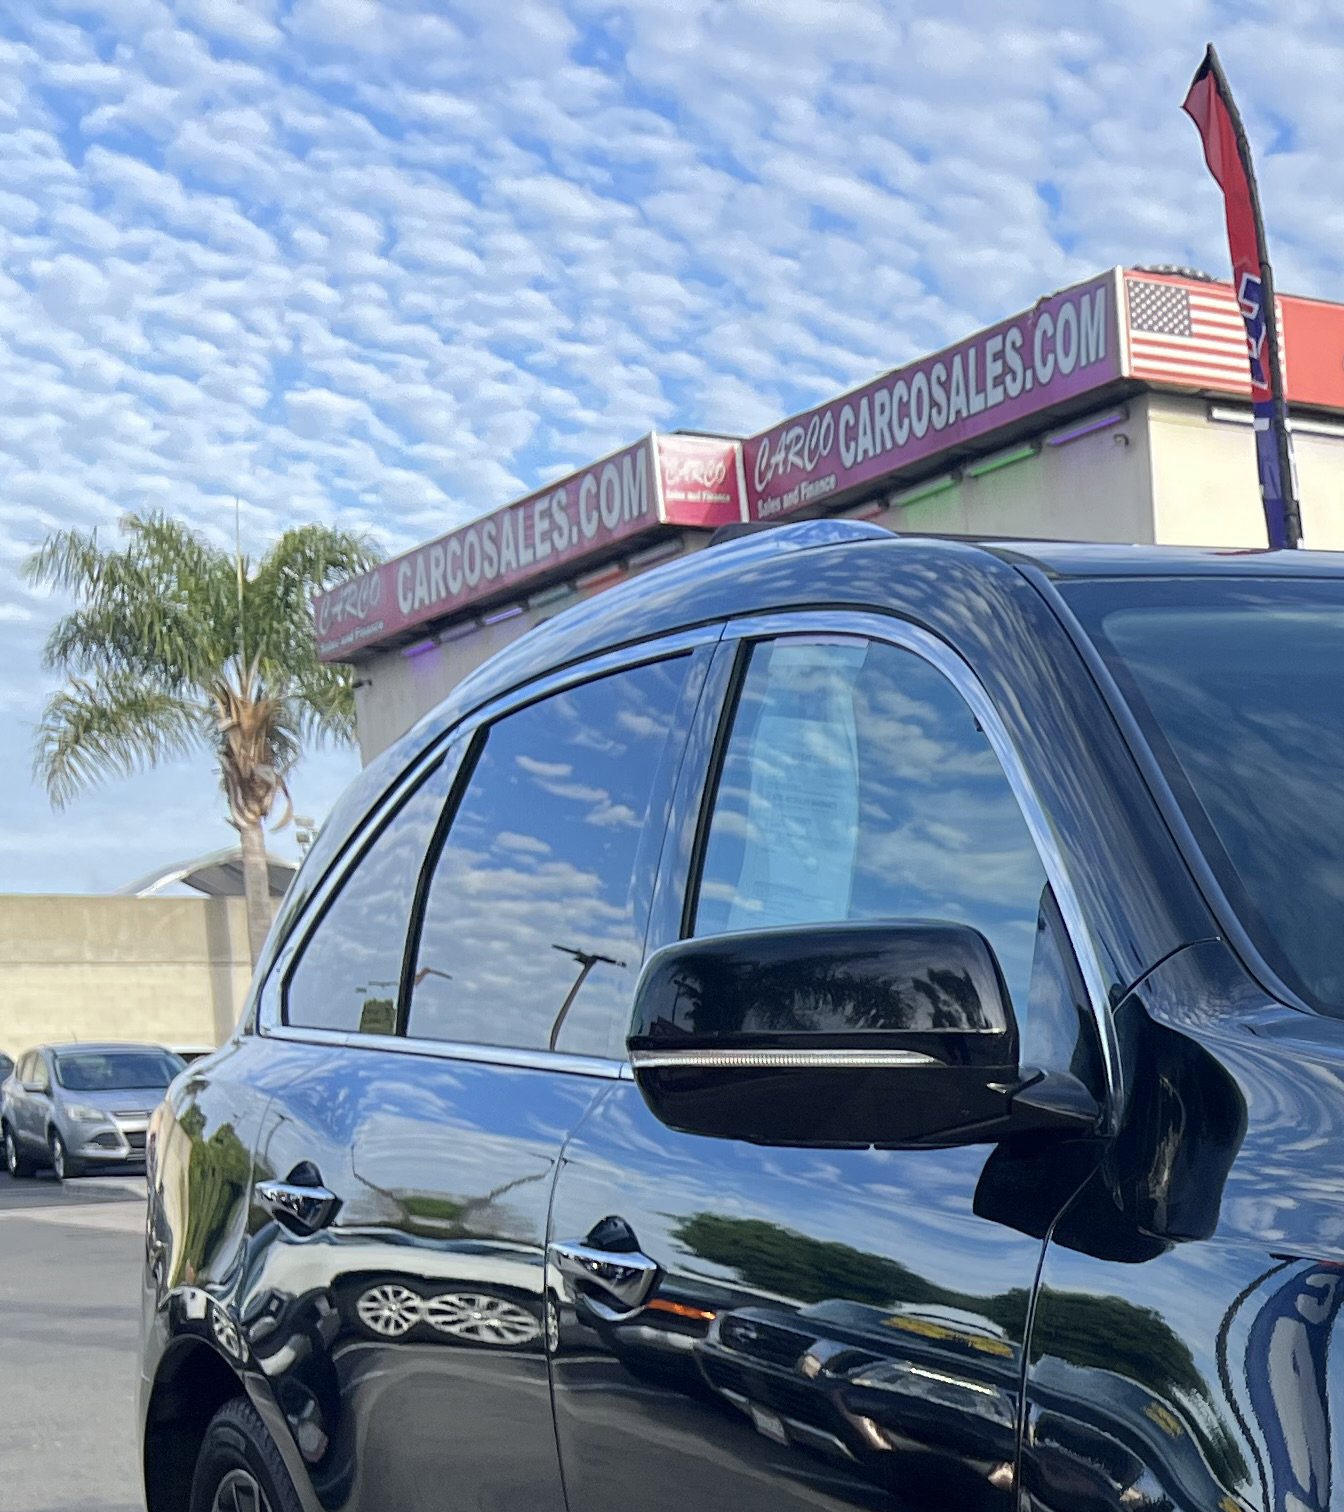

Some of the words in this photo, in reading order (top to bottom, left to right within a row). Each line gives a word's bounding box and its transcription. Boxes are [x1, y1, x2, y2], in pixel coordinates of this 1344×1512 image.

[754, 409, 835, 494] CARCO
[838, 286, 1107, 470] CARCOSALES.COM
[396, 446, 649, 616] CARCOSALES.COM
